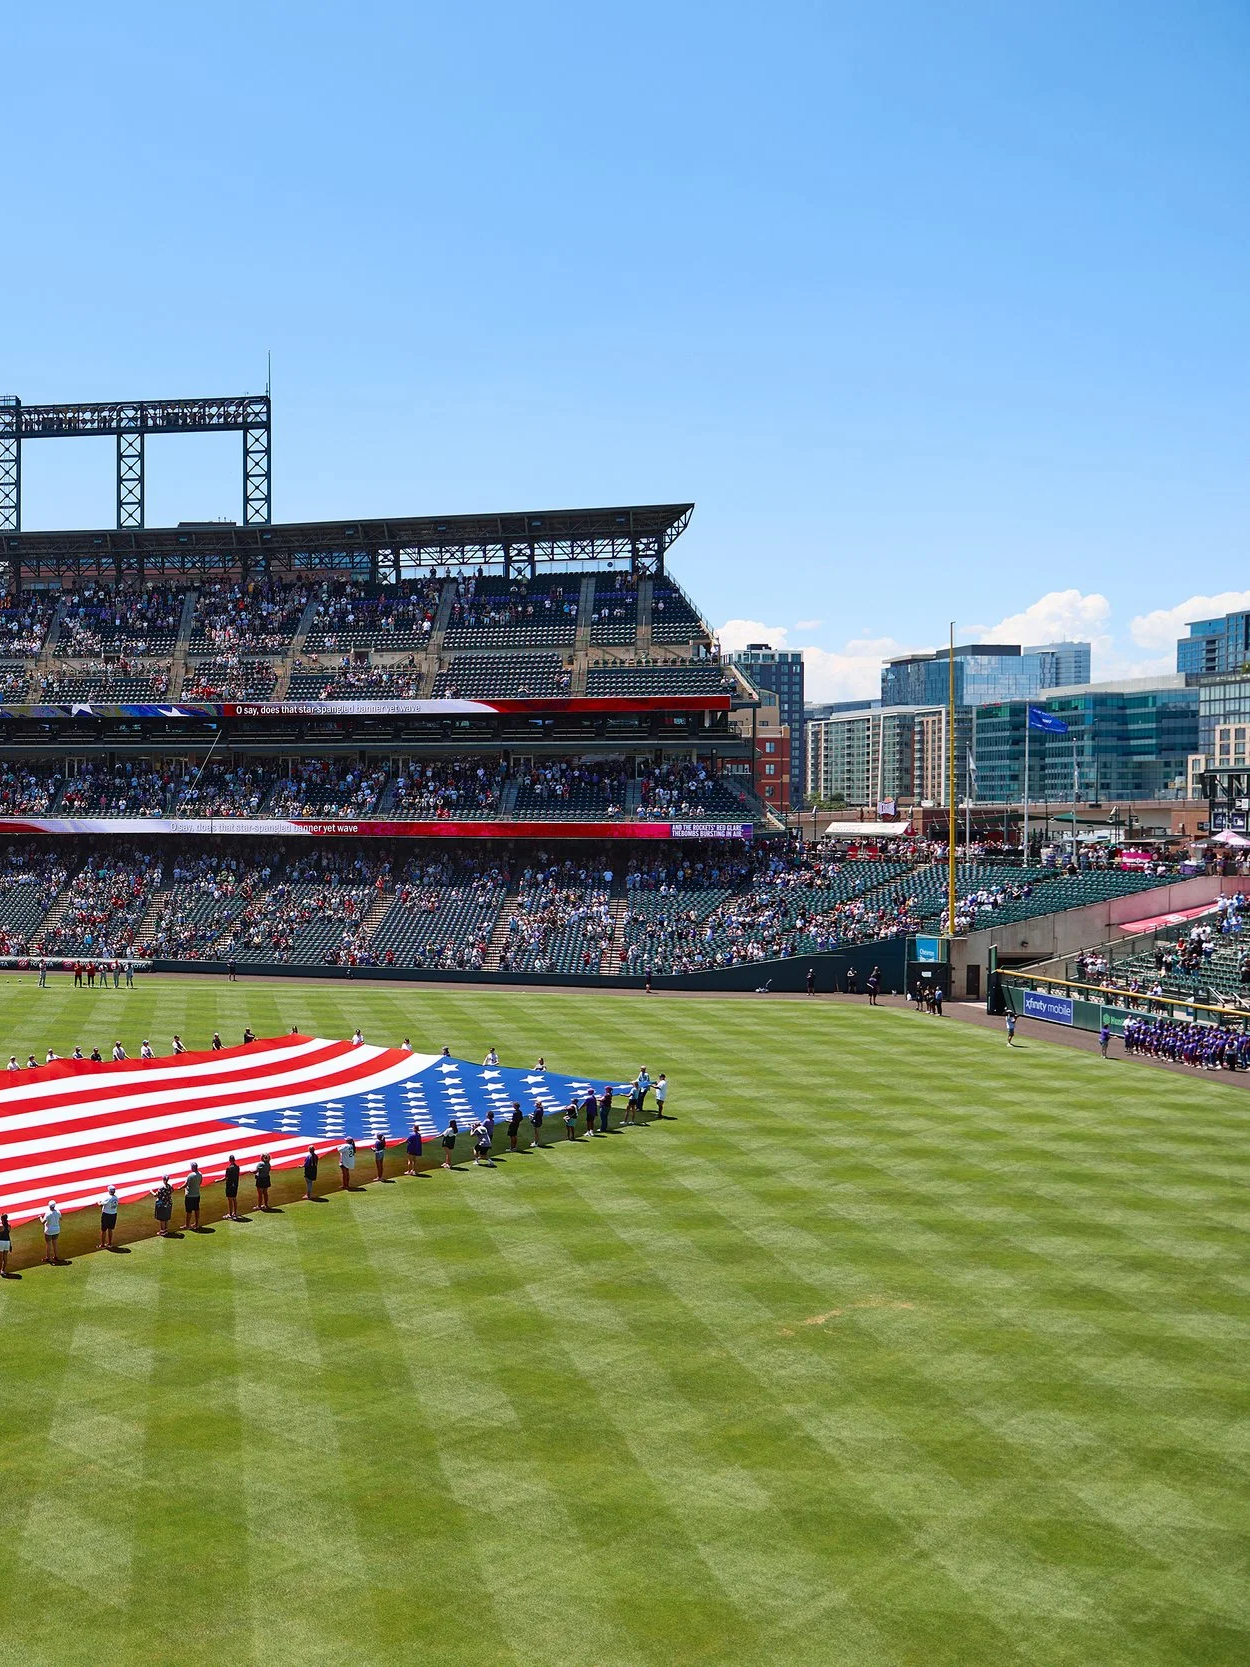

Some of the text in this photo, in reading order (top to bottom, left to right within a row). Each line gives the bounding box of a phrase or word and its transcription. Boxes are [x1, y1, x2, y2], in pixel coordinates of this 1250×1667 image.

[236, 704, 421, 716] O say, does that star-spangled banner yet wave
[322, 823, 336, 834] yet
[337, 824, 358, 833] wave
[1025, 997, 1071, 1016] xfinity mobile
